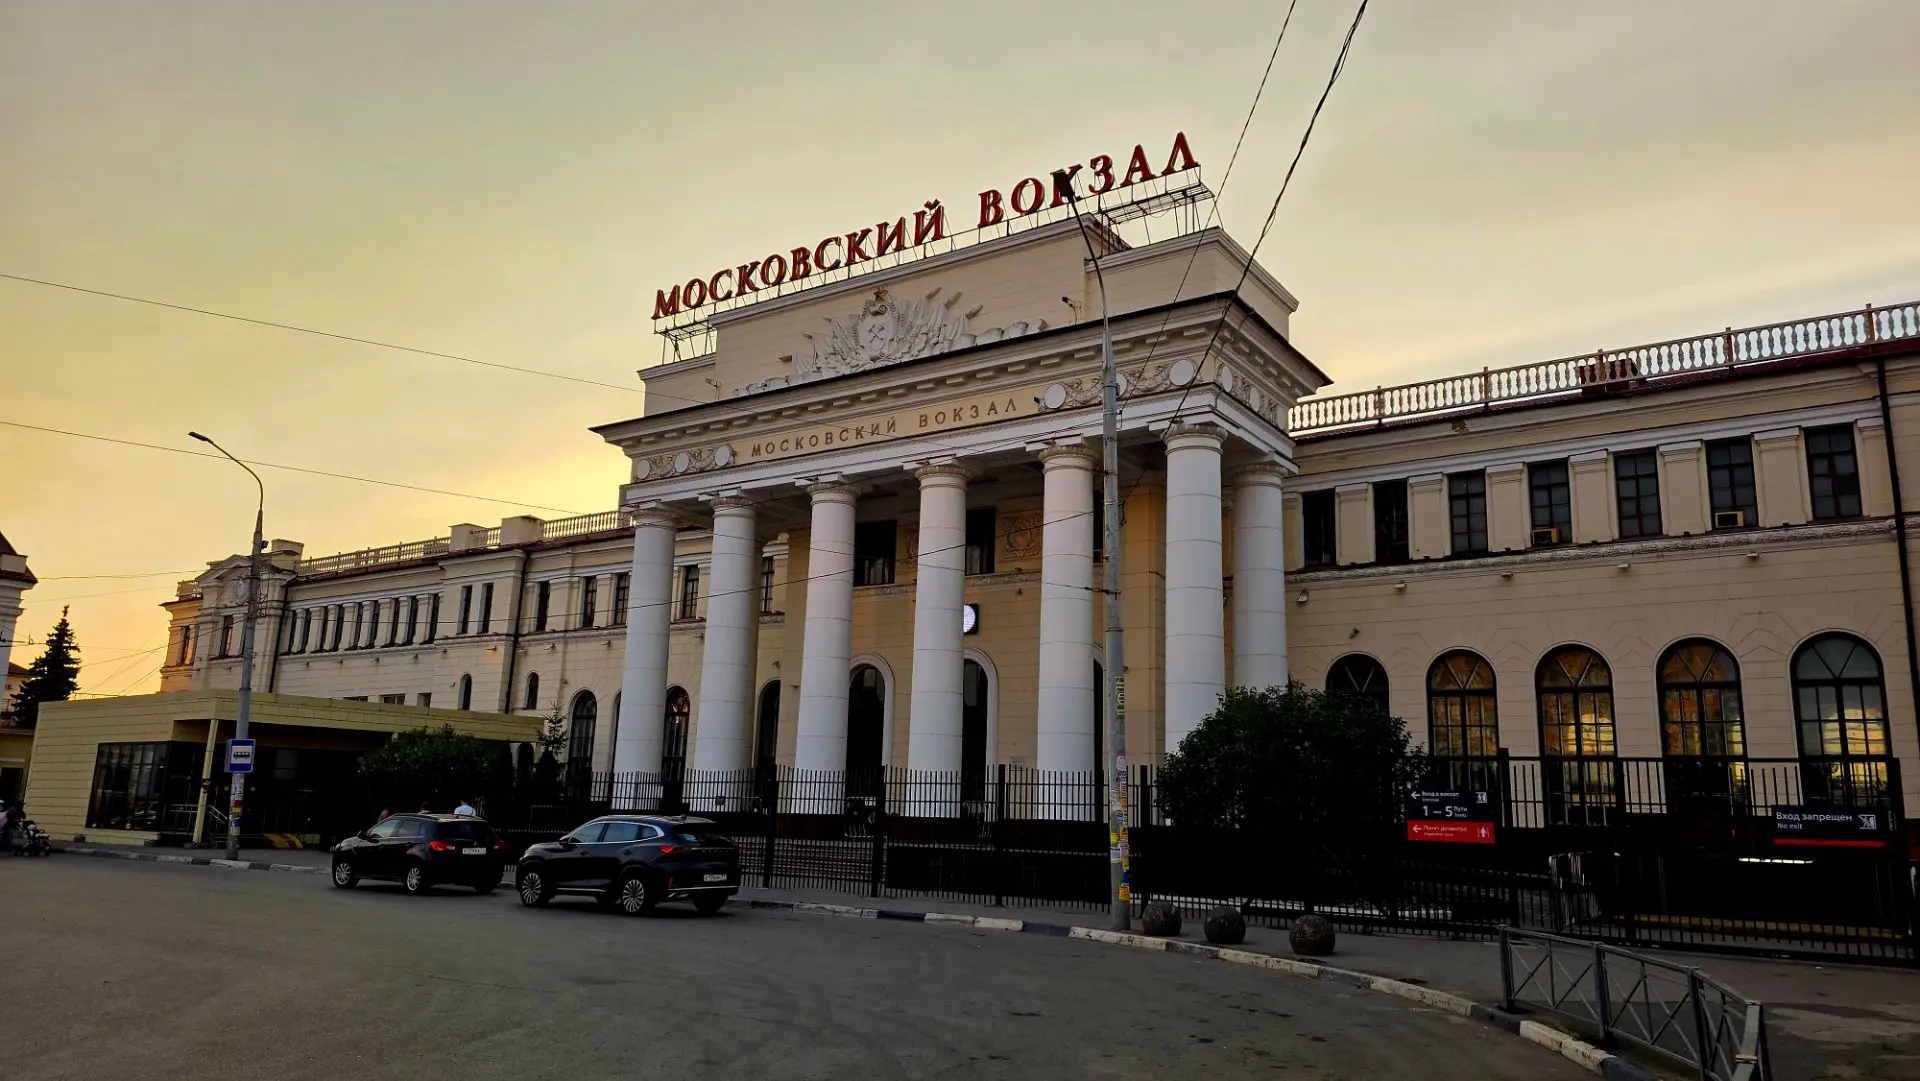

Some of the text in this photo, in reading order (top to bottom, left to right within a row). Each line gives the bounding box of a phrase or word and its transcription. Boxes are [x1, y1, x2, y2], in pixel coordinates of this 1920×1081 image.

[651, 131, 1201, 319] МОСКОВСКИЙ ВОКЗАЛ
[751, 397, 1017, 457] МОСКОВСКИЙ ВОКЗАЛ
[1422, 805, 1428, 817] 1
[1445, 805, 1453, 817] 5
[1775, 811, 1853, 823] Вход запрещен
[1777, 822, 1803, 830] No exit
